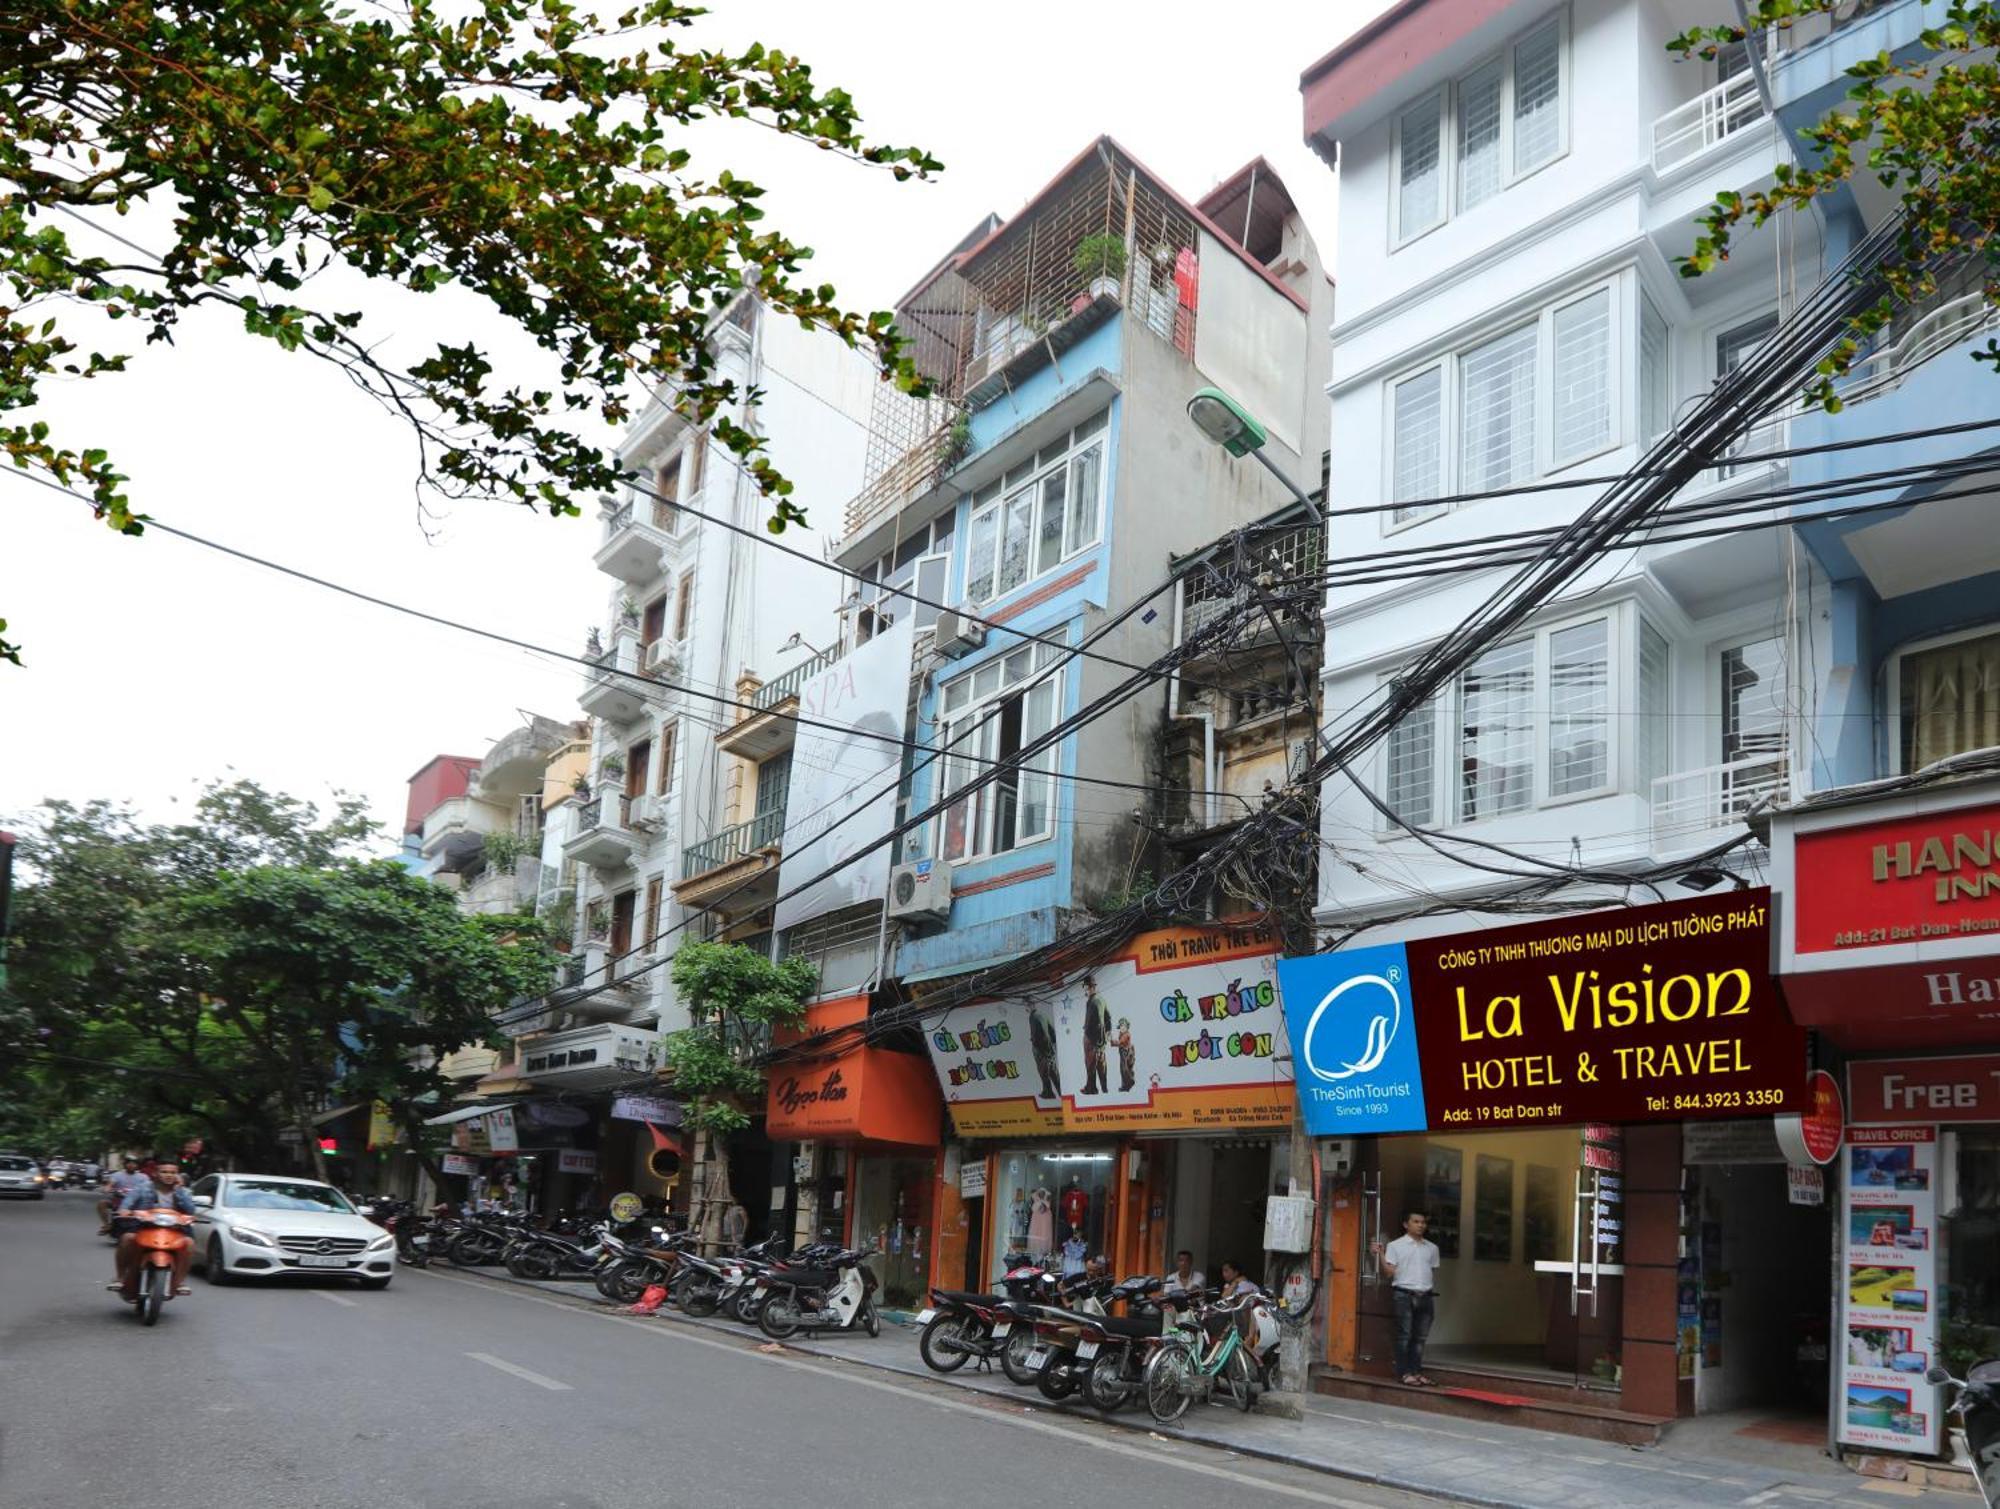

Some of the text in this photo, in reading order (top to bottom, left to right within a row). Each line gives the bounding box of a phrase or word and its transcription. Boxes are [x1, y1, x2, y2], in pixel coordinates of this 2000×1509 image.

[1872, 829, 2000, 881] HAN
[1181, 936, 1221, 957] TRANG
[1438, 949, 1477, 970] CÔNG
[1478, 947, 1493, 965] TY
[1494, 943, 1527, 963] TNHH
[1528, 934, 1583, 959] THƯƠNG
[1586, 930, 1612, 952] MẠI
[1616, 927, 1634, 946] DU
[1637, 921, 1669, 946] LỊCH
[1727, 904, 1766, 931] PHÁT
[1456, 963, 1752, 1042] La Vision
[1923, 971, 2000, 1007] Ha
[1160, 988, 1194, 1023] GÀ
[1227, 1031, 1275, 1058] CON
[986, 1058, 1020, 1080] CON
[1461, 1039, 1752, 1091] HOTEL & TRAVEL
[1646, 1088, 1784, 1111] Tel: 844.3923 3350
[1883, 1074, 1978, 1110] Free
[1336, 1102, 1389, 1118] Since 1993
[1442, 1103, 1562, 1123] Add: 19 Bat Dan str
[1852, 1129, 1928, 1141] TRAVEL OFFICE
